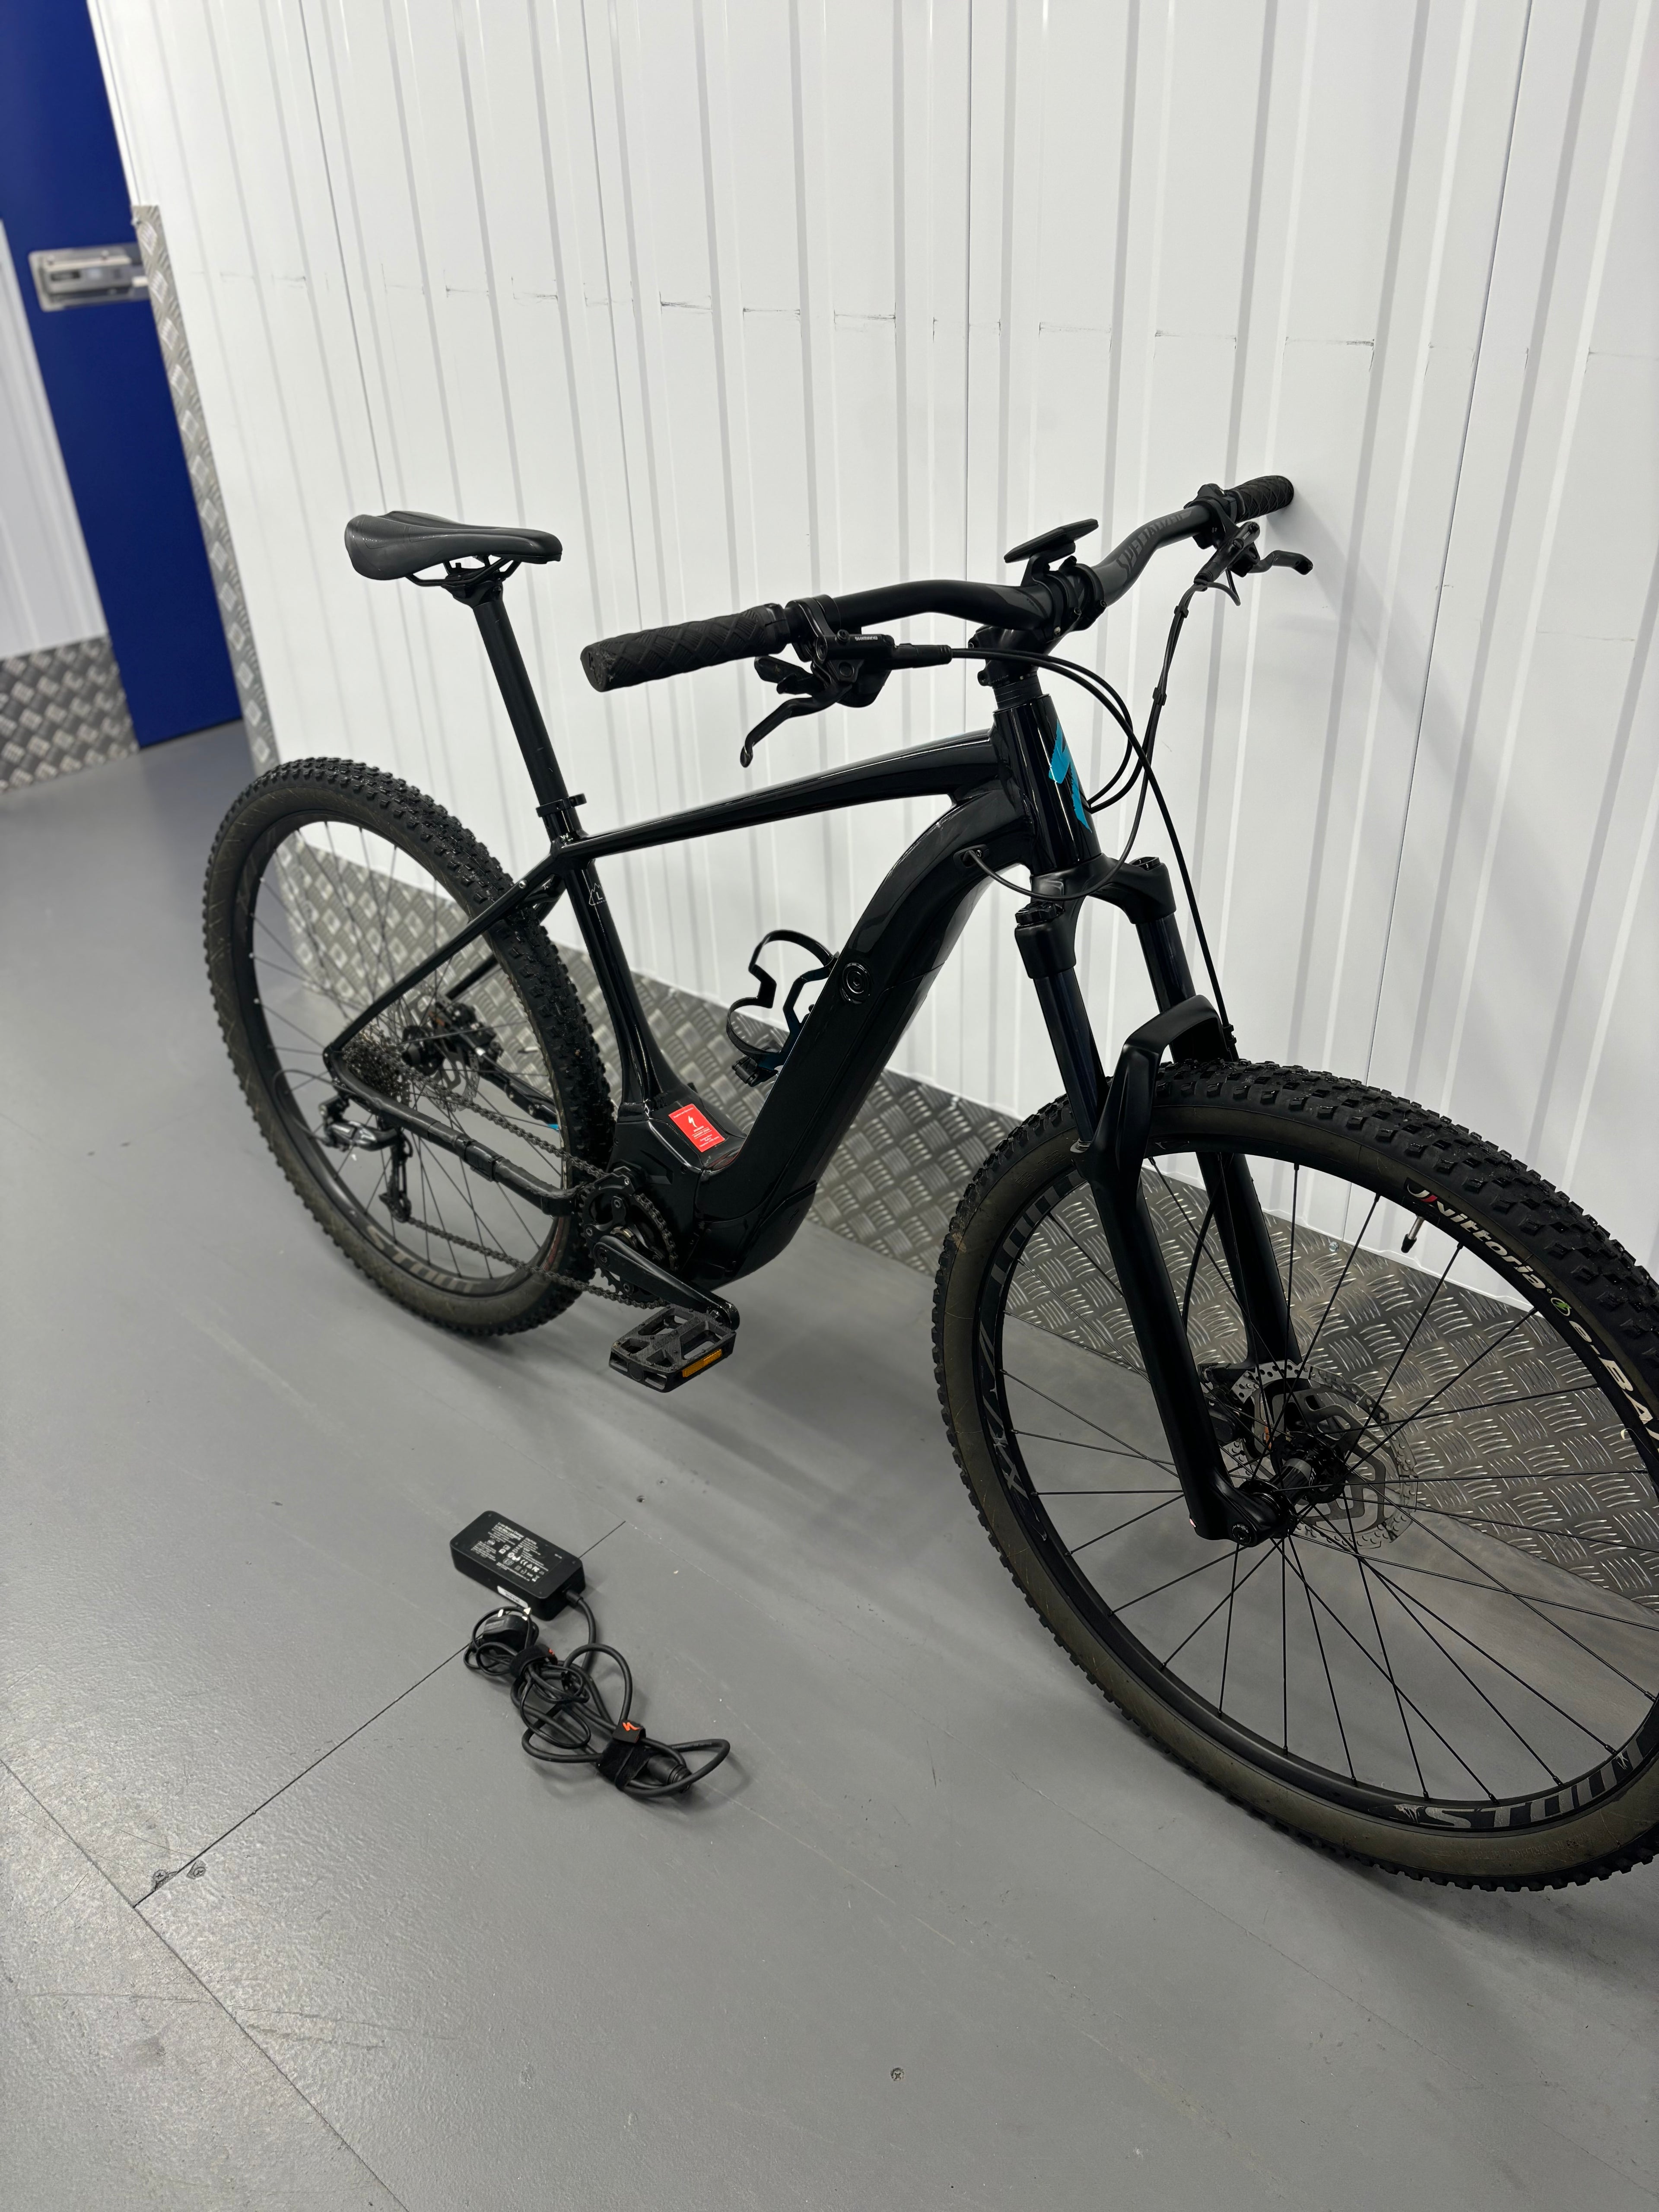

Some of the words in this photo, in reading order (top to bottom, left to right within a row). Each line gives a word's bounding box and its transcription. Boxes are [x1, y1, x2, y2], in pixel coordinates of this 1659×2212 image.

[596, 892, 603, 900] L
[1437, 1201, 1545, 1290] vittoria
[1418, 1726, 1645, 1828] STOUT
